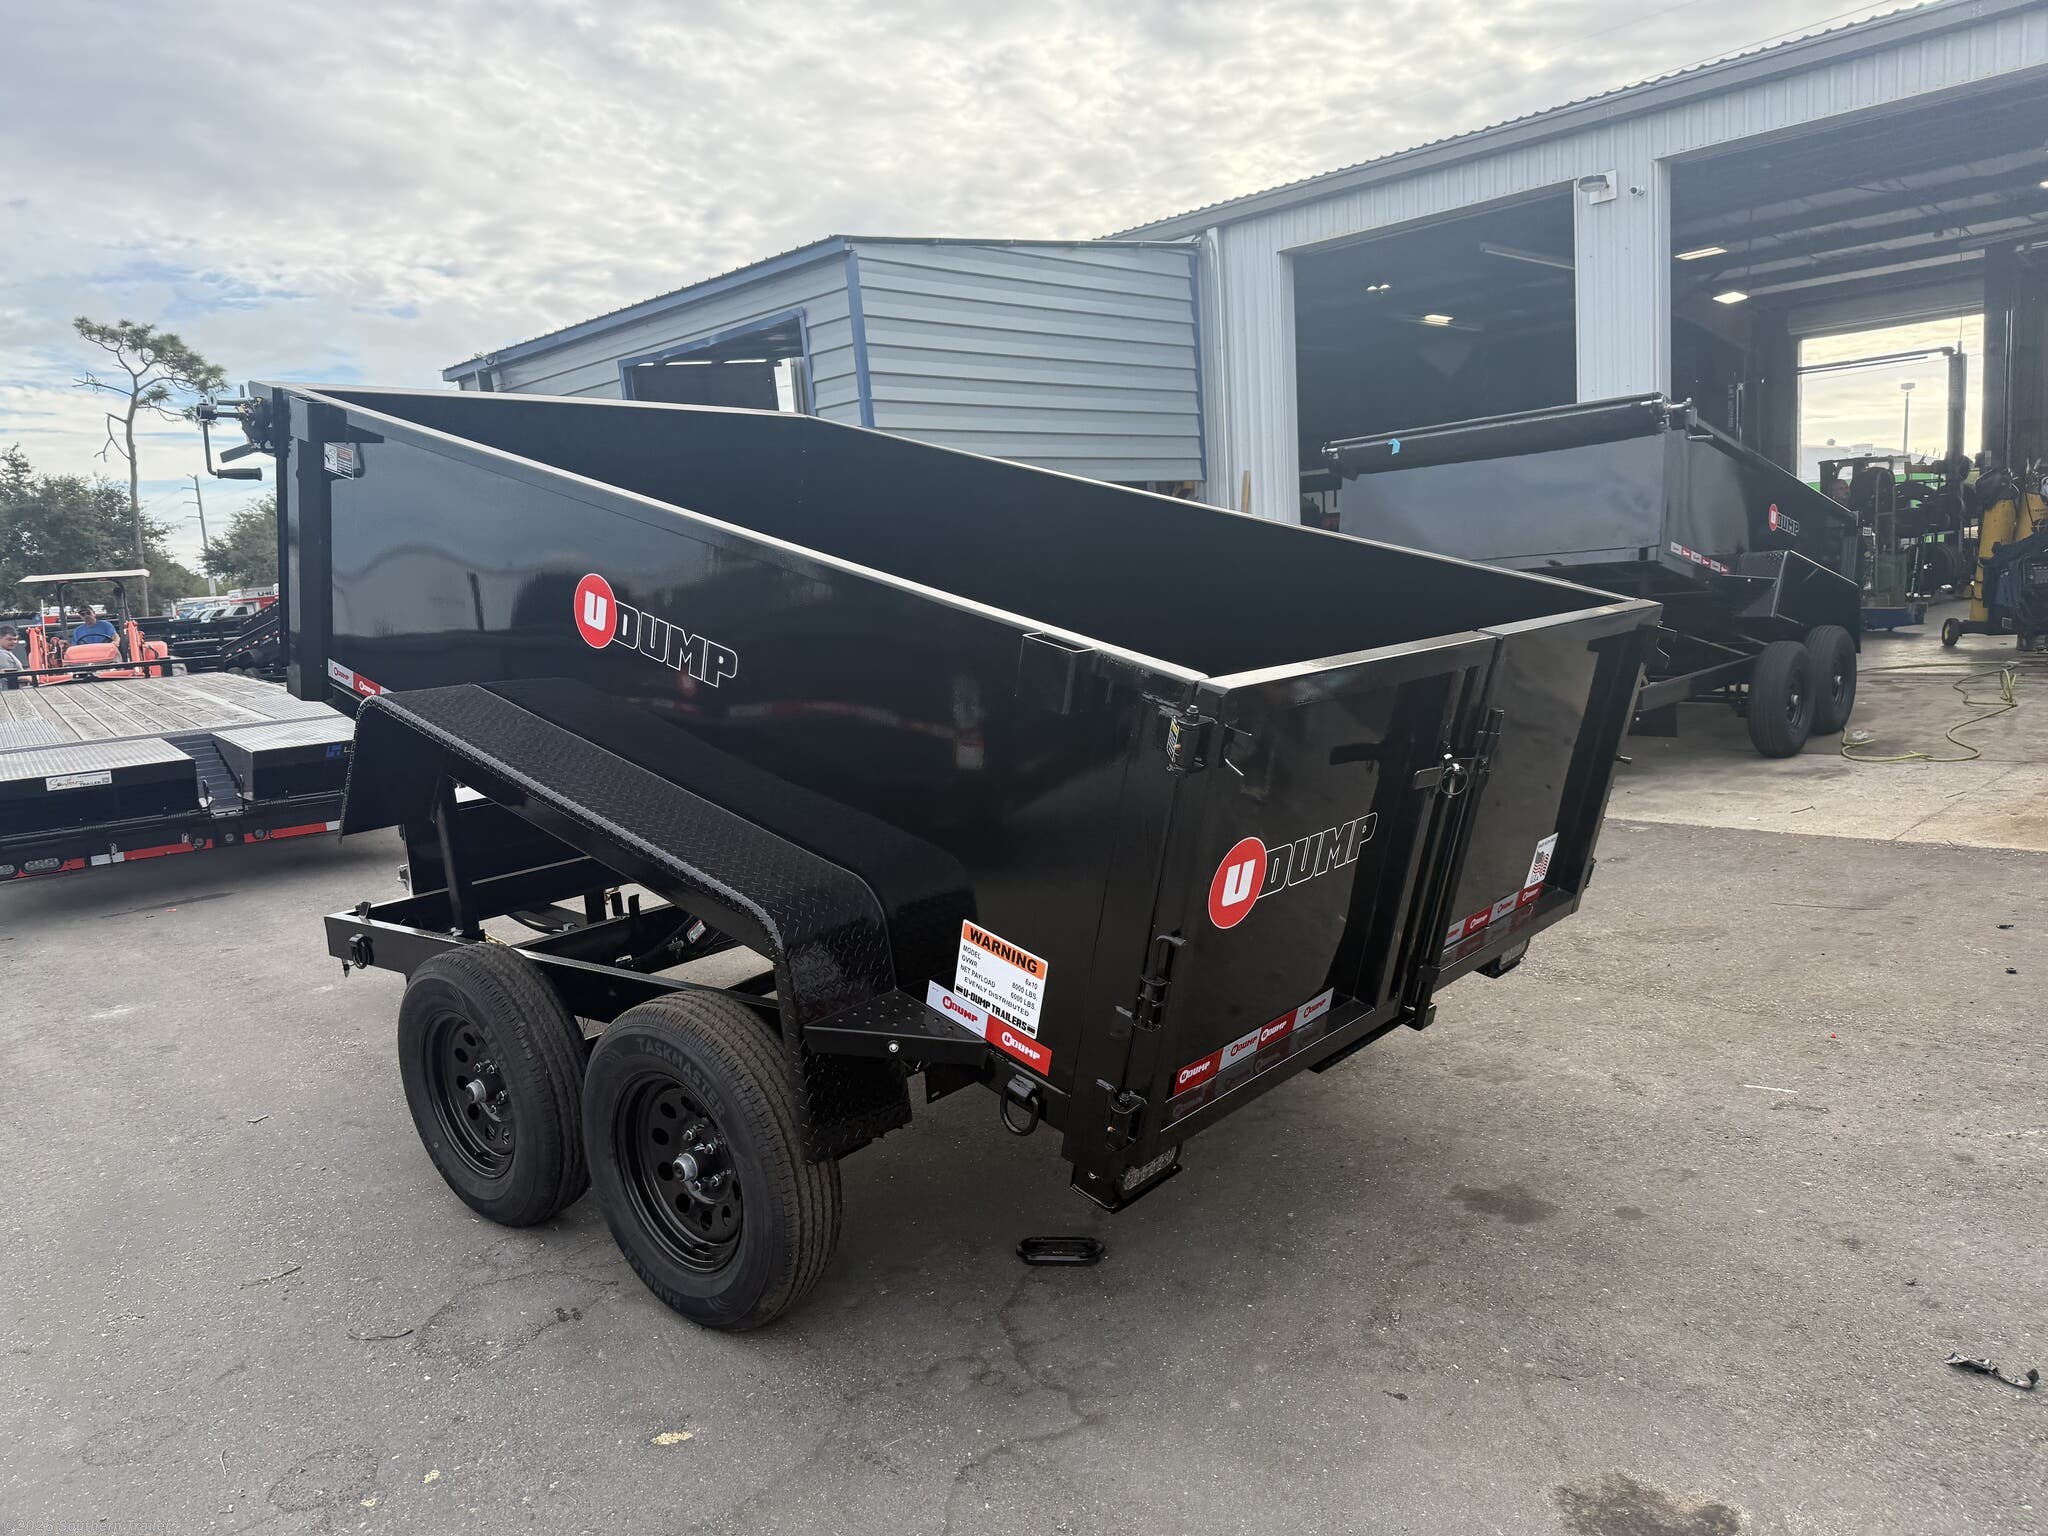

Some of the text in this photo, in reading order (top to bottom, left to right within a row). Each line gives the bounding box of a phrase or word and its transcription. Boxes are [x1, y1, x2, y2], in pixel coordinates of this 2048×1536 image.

[961, 954, 978, 968] GVWR
[963, 944, 981, 960] MODEL
[970, 928, 1038, 974] WARNING
[960, 964, 996, 988] NET PAYLOAD
[964, 976, 1030, 1018] EVENLY DISTRIBUTED
[962, 988, 1027, 1031] U-DUMP TRAILERS
[636, 1037, 726, 1119] TASKMASTER
